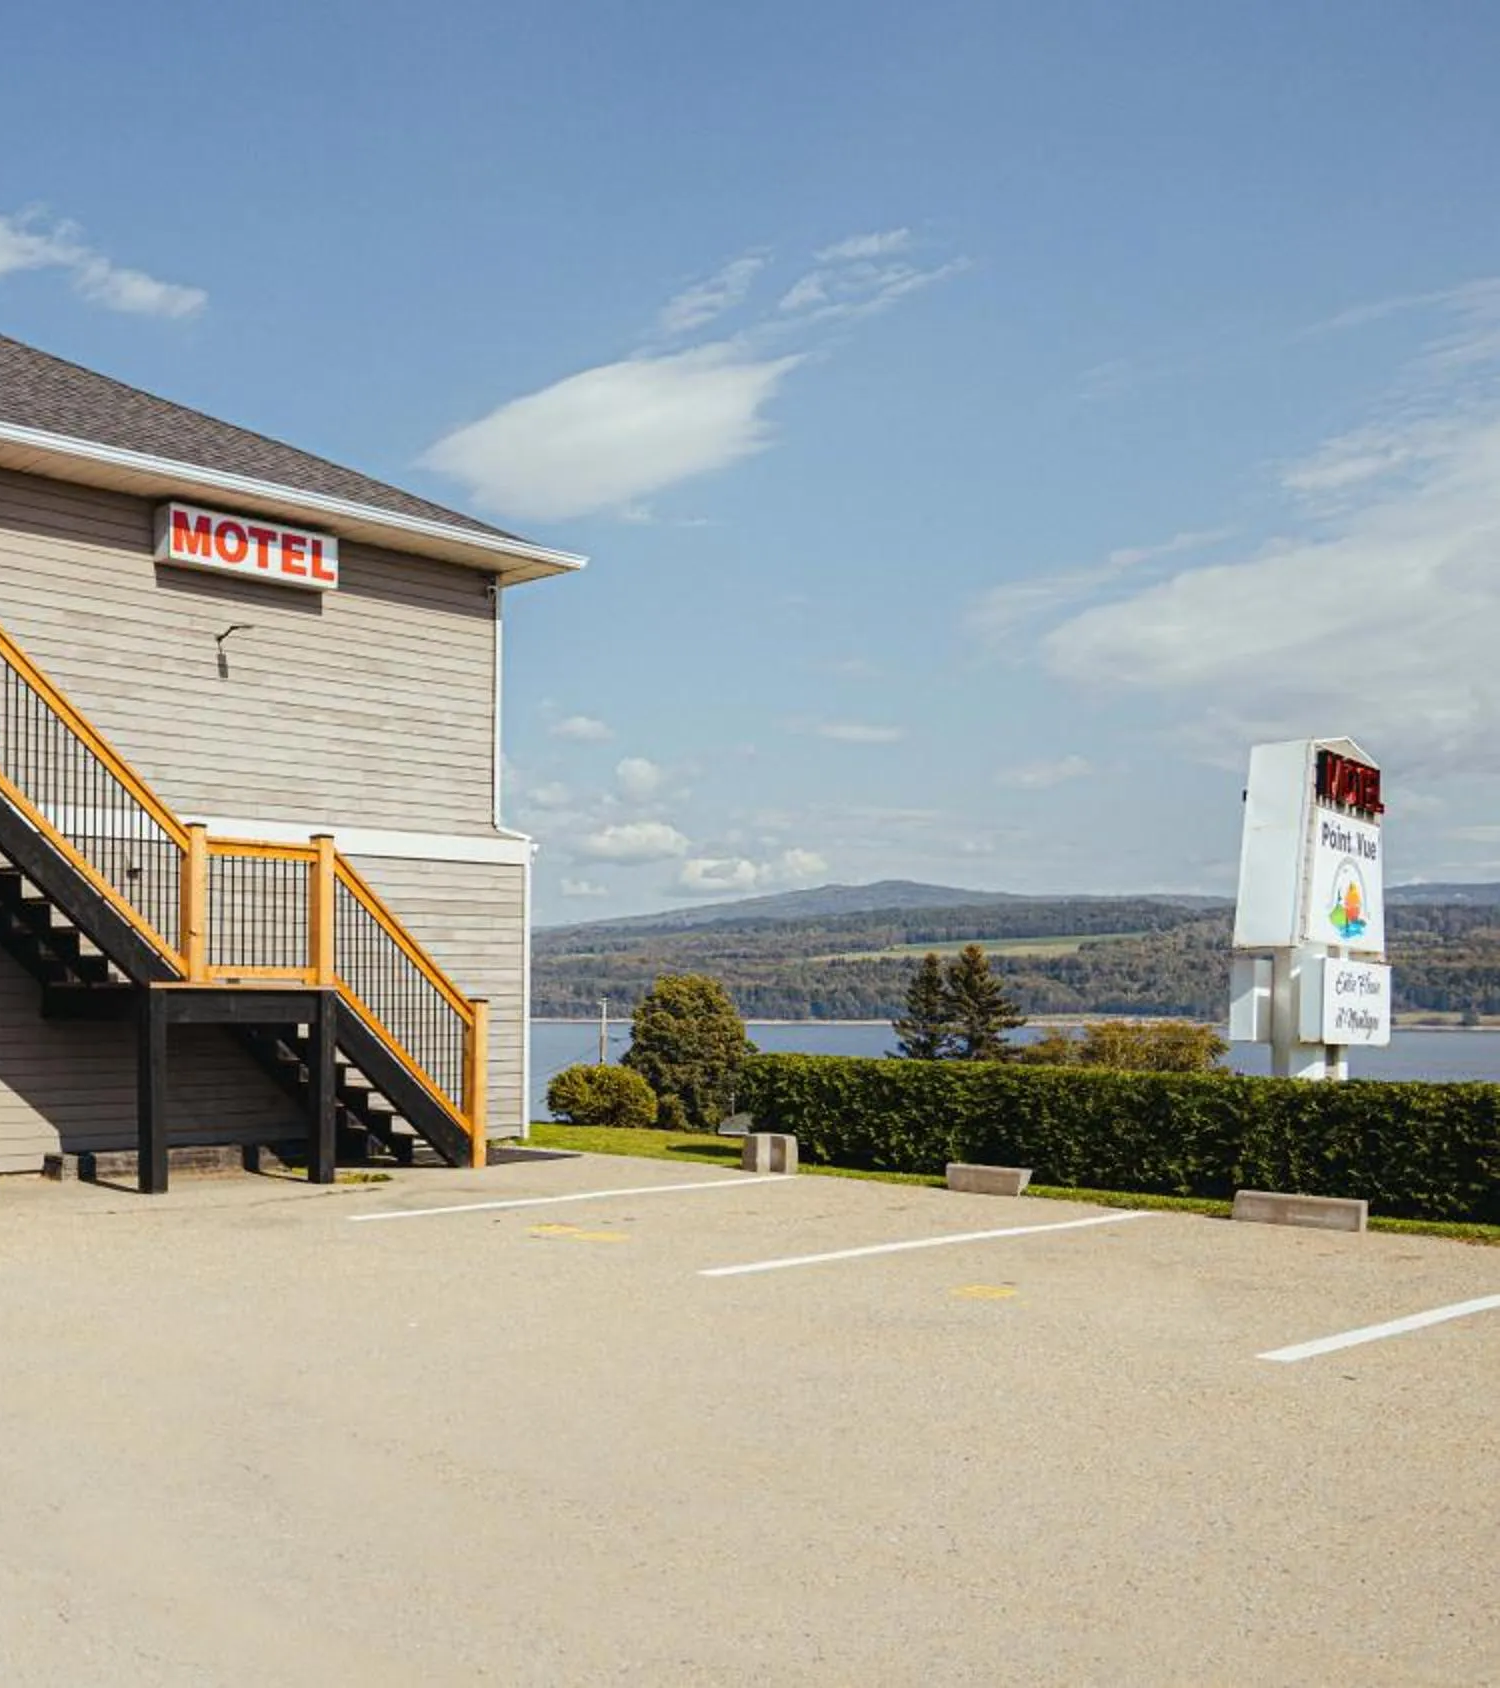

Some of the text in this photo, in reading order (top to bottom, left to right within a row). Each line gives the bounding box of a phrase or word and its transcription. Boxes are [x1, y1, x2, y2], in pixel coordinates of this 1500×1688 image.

[172, 509, 335, 581] MOTEL
[1321, 821, 1377, 861] Point Vue
